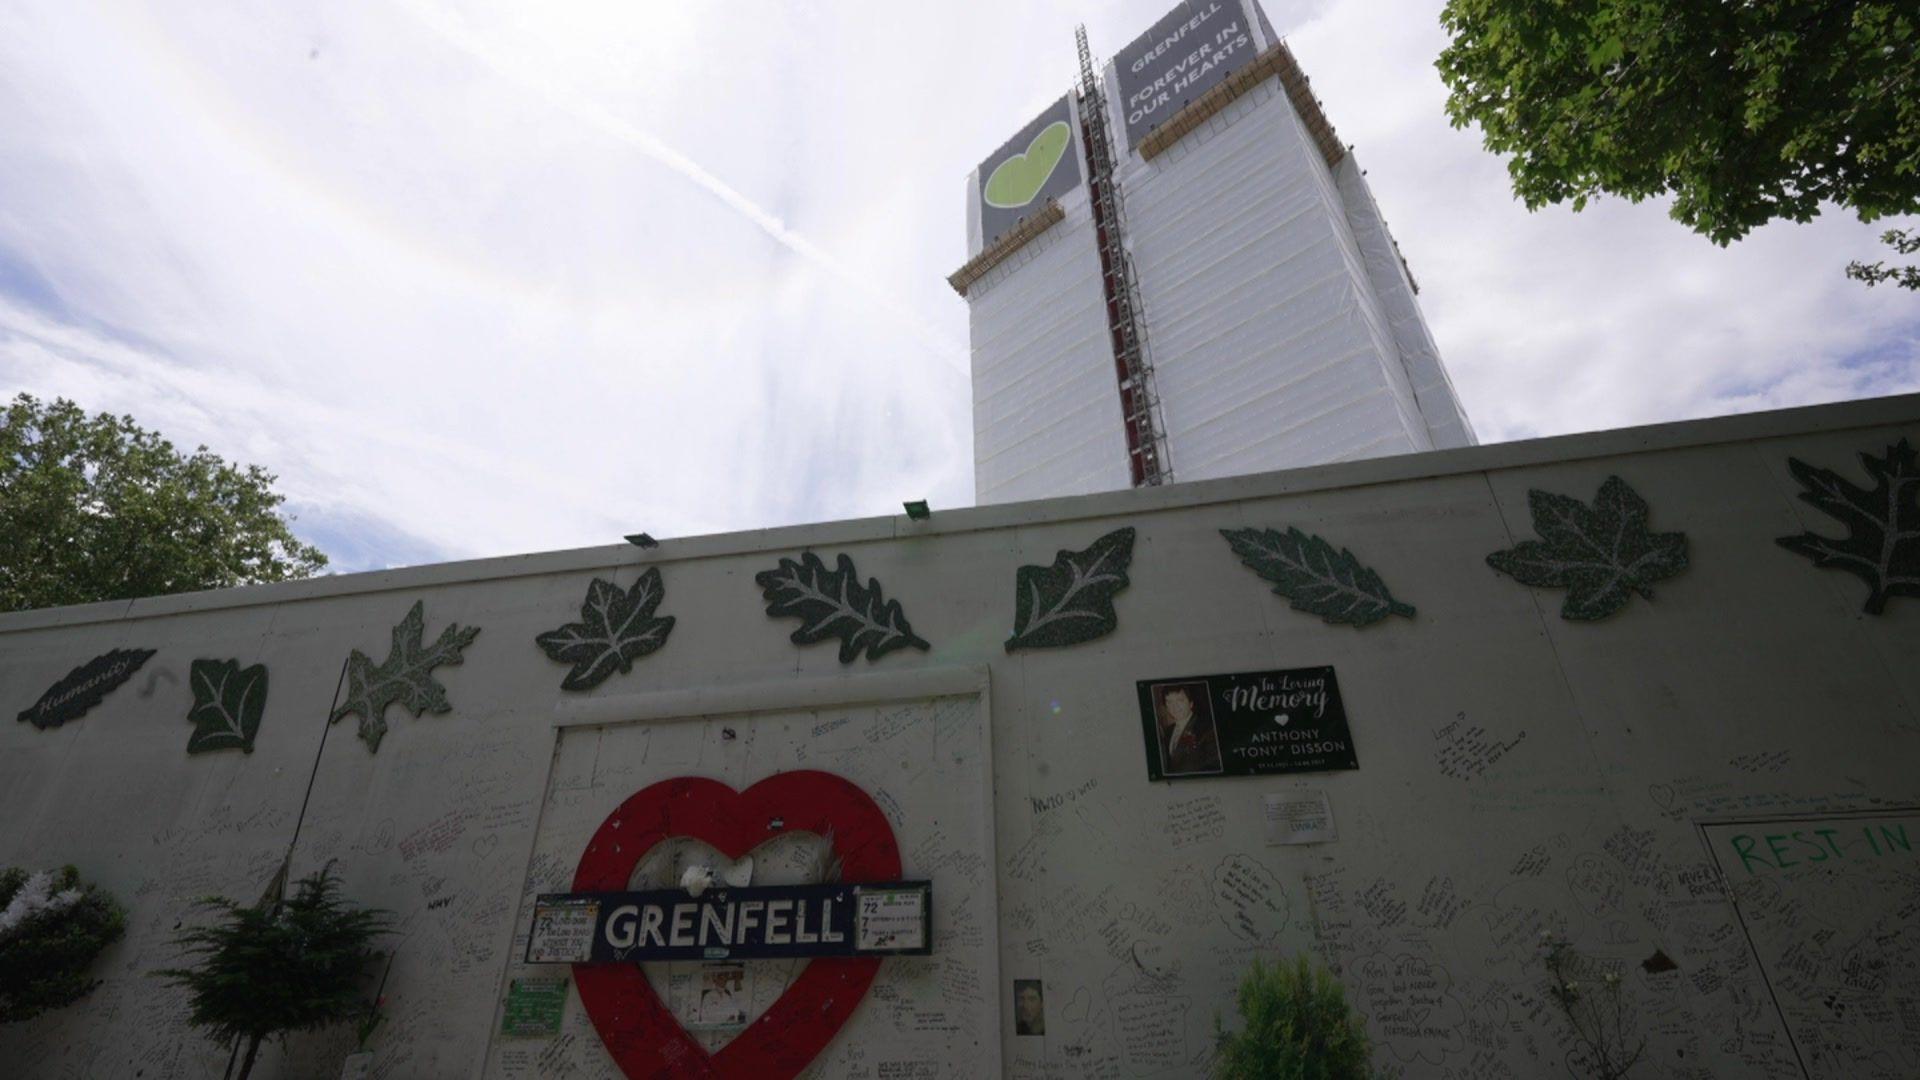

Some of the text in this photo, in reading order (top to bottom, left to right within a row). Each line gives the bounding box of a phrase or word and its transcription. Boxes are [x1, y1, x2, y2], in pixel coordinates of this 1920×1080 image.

[1131, 2, 1222, 73] GRENFELL
[1128, 33, 1248, 125] OUR HEARTS
[1129, 21, 1238, 109] FOREVER IN
[1223, 686, 1329, 718] Memory
[1262, 675, 1324, 692] In Loving
[1233, 741, 1345, 759] "TONY" DISSON
[1251, 729, 1319, 744] ANTHONY
[1731, 823, 1912, 874] REST IN
[604, 898, 845, 949] GRENFELL
[863, 902, 878, 914] 72
